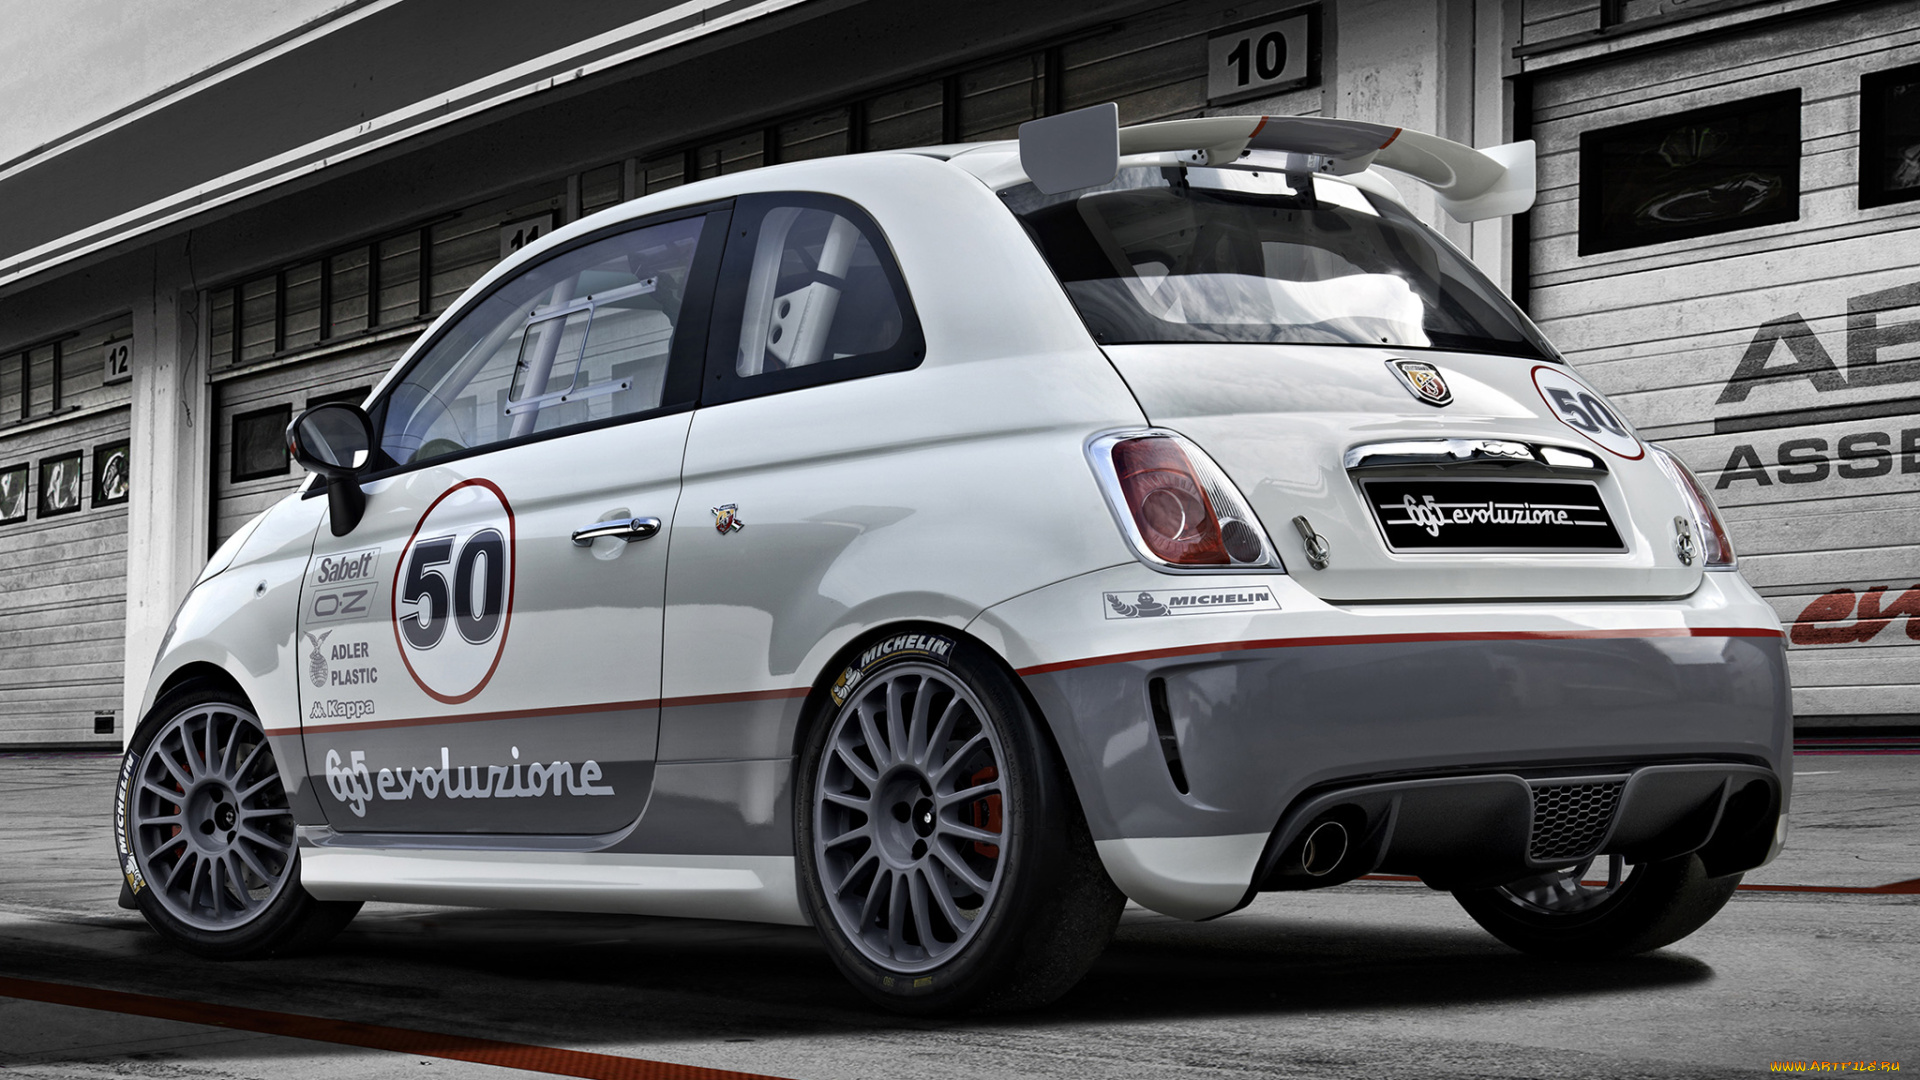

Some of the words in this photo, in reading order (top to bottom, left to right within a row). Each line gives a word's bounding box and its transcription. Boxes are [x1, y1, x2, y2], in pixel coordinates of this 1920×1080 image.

[1227, 31, 1287, 87] 10
[109, 345, 128, 376] 12
[1544, 386, 1630, 439] 50
[1403, 494, 1446, 537] 695
[1452, 501, 1576, 525] evoluzione
[318, 552, 373, 583] Sabelt
[399, 527, 506, 650] 50
[1169, 593, 1269, 606] MICHELIN
[331, 642, 369, 660] ADLER
[860, 634, 950, 668] MICHELIN
[331, 667, 378, 686] PLASTIC
[328, 699, 375, 718] Kappa
[325, 748, 374, 817] 695
[377, 746, 615, 800] evoluzione
[117, 753, 135, 855] MICHELIN
